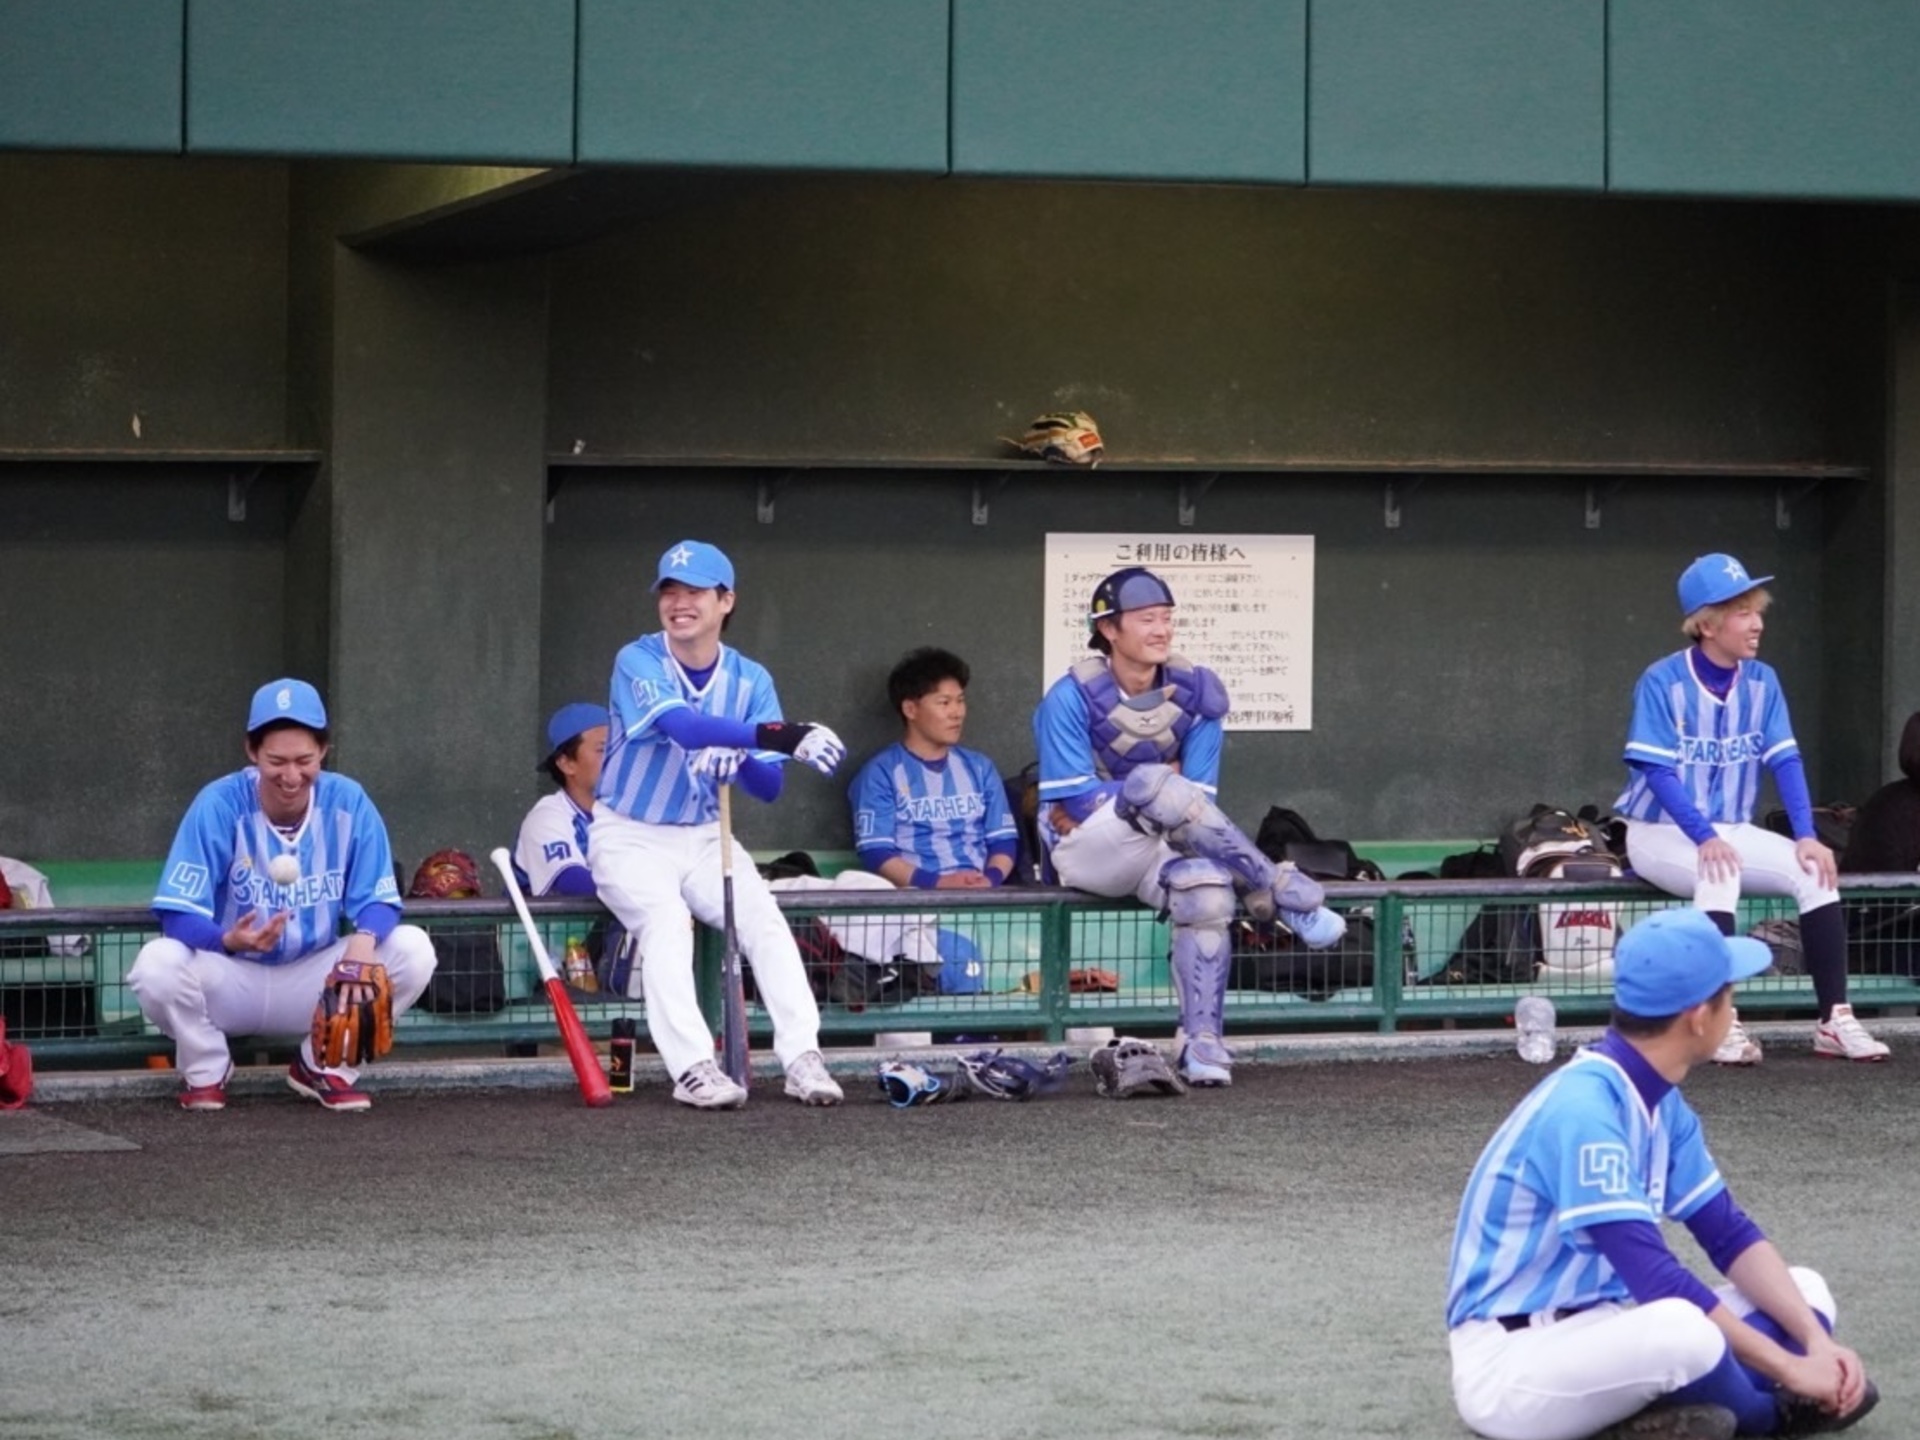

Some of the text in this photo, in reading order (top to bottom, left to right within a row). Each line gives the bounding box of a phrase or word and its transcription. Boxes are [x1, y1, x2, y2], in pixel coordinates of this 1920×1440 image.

[1115, 543, 1246, 562] ご利用の皆様へ
